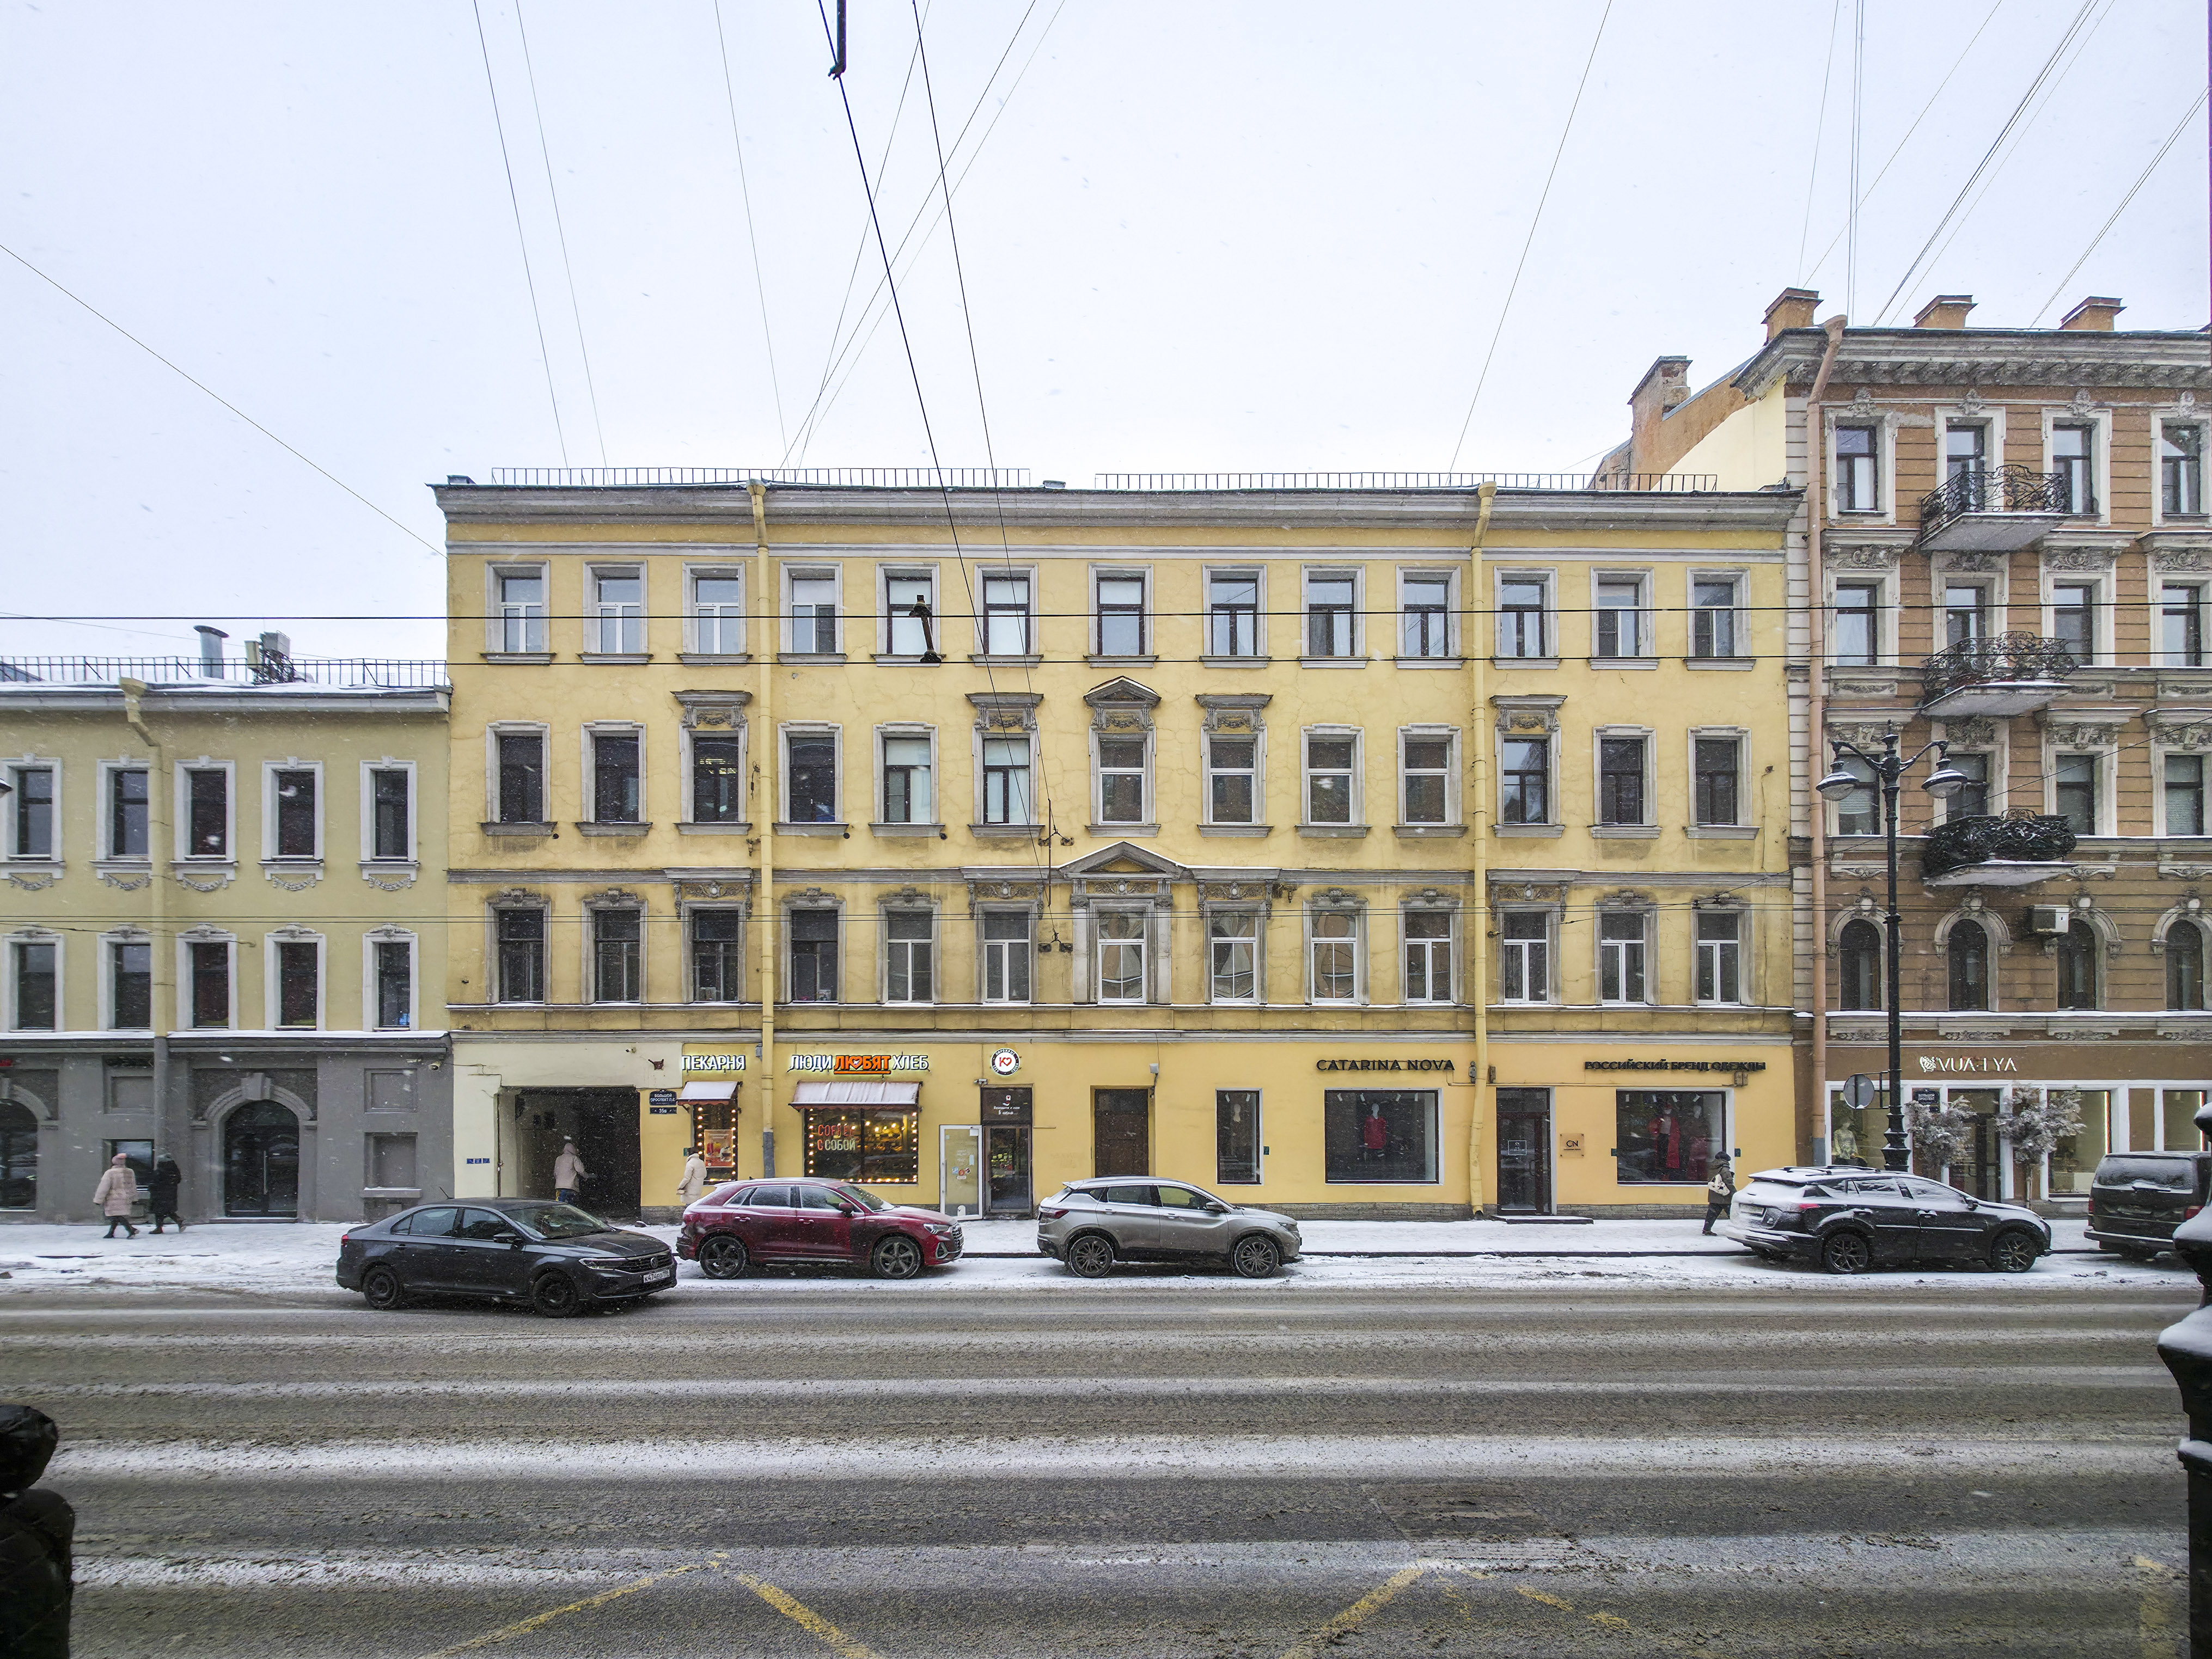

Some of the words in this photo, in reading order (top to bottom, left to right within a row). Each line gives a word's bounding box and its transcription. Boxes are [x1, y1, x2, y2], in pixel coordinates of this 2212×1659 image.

[682, 1055, 746, 1070] ПЕКАРНЯ
[790, 1055, 833, 1072] ЛЮДИ
[834, 1055, 891, 1070] ЛЮБЯТ
[892, 1055, 929, 1070] ХЛЕБ
[1316, 1060, 1402, 1071] CATARINA
[1407, 1060, 1455, 1071] NOVA
[1585, 1058, 1668, 1070] РОССИЙСКИЙ
[1671, 1062, 1709, 1072] БРЕНД
[1712, 1062, 1766, 1072] ОДЕЖДЫ
[824, 1138, 856, 1150] СОБОЙ
